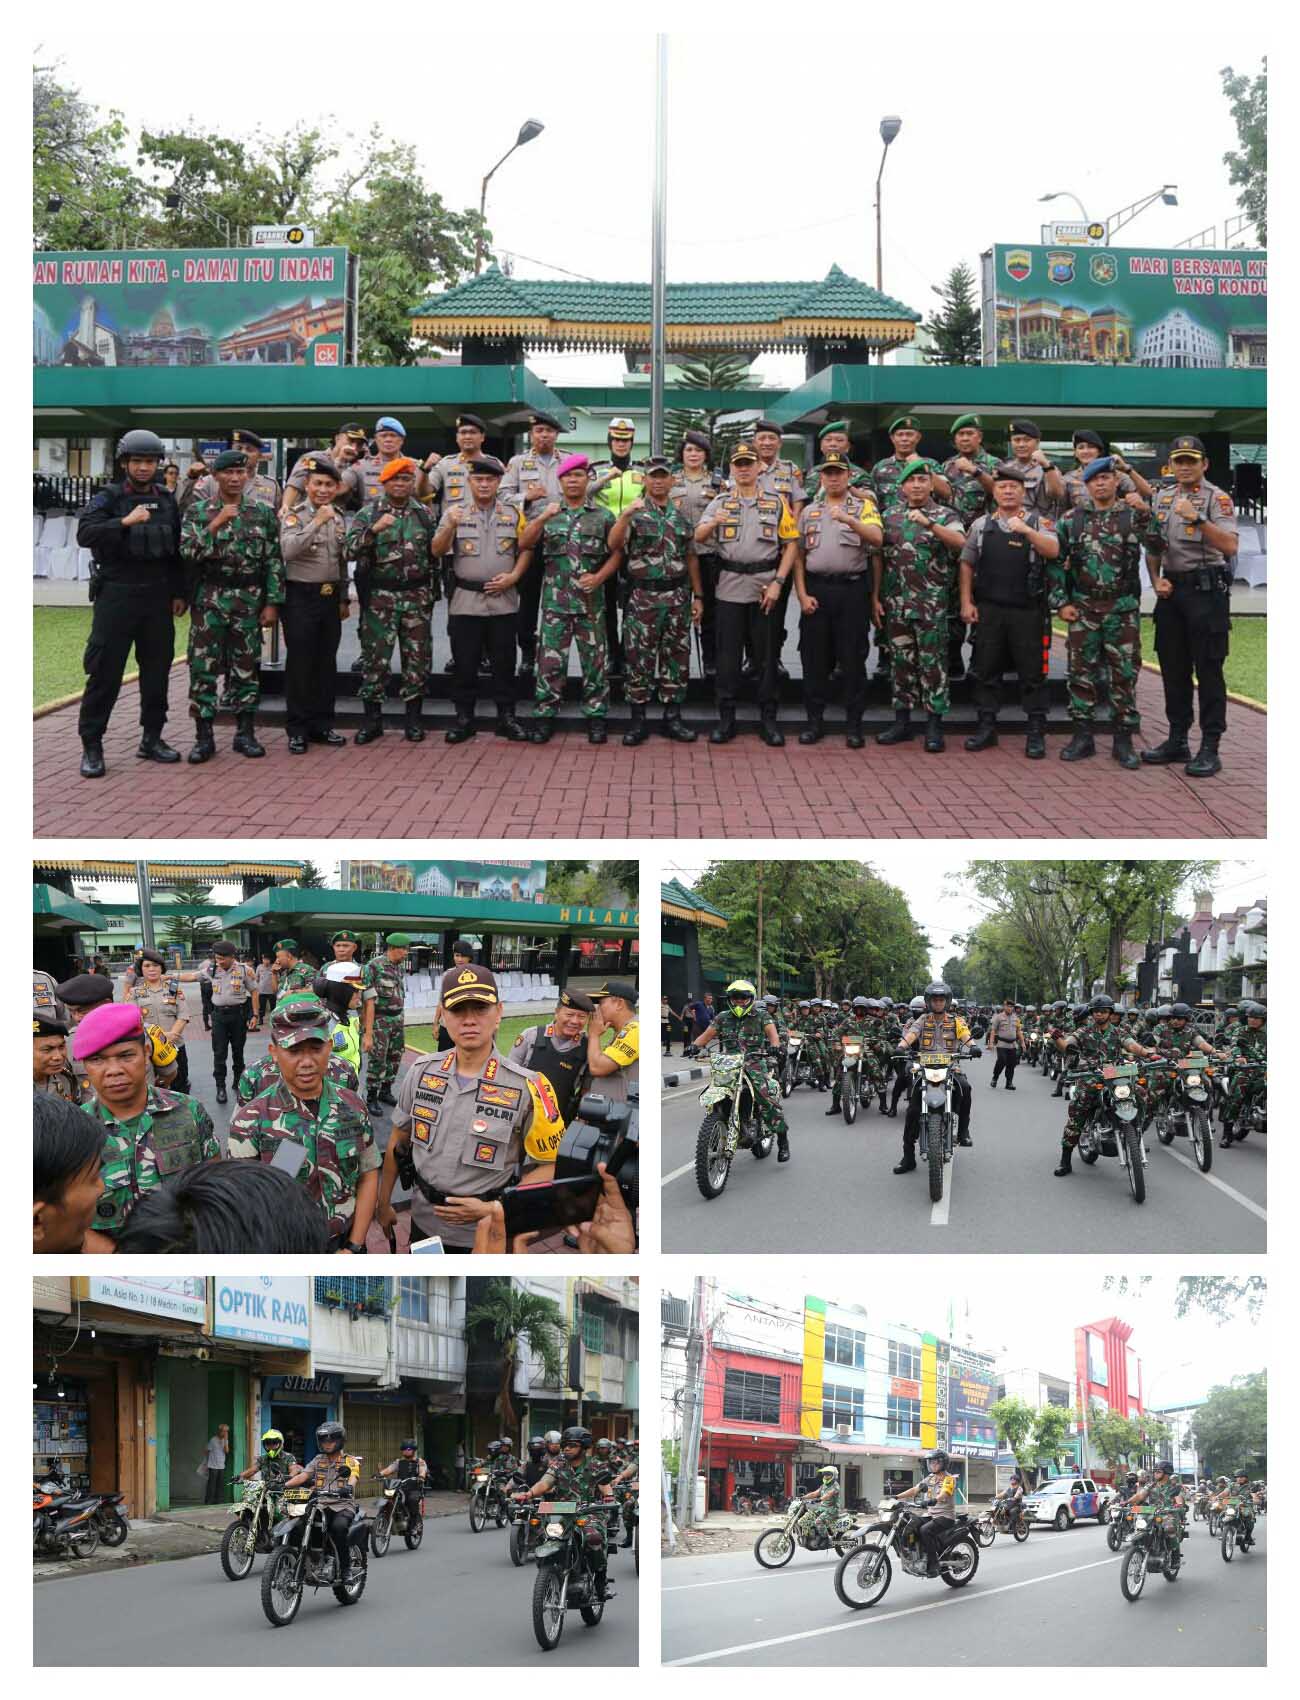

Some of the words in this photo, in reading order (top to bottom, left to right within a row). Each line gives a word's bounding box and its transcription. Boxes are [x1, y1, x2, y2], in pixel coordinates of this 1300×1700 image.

[33, 261, 57, 284] AN
[62, 260, 123, 284] RUMAH
[127, 259, 168, 283] KITA
[183, 258, 238, 283] DAMAI
[244, 258, 275, 282] ITU
[279, 257, 334, 282] INDAH
[1129, 256, 1168, 275] MARI
[1172, 258, 1243, 276] BERSAMA
[1173, 277, 1214, 294] YANG
[476, 1104, 514, 1121] POLRI
[219, 1286, 268, 1320] OPTIK
[271, 1297, 308, 1328] RAYA
